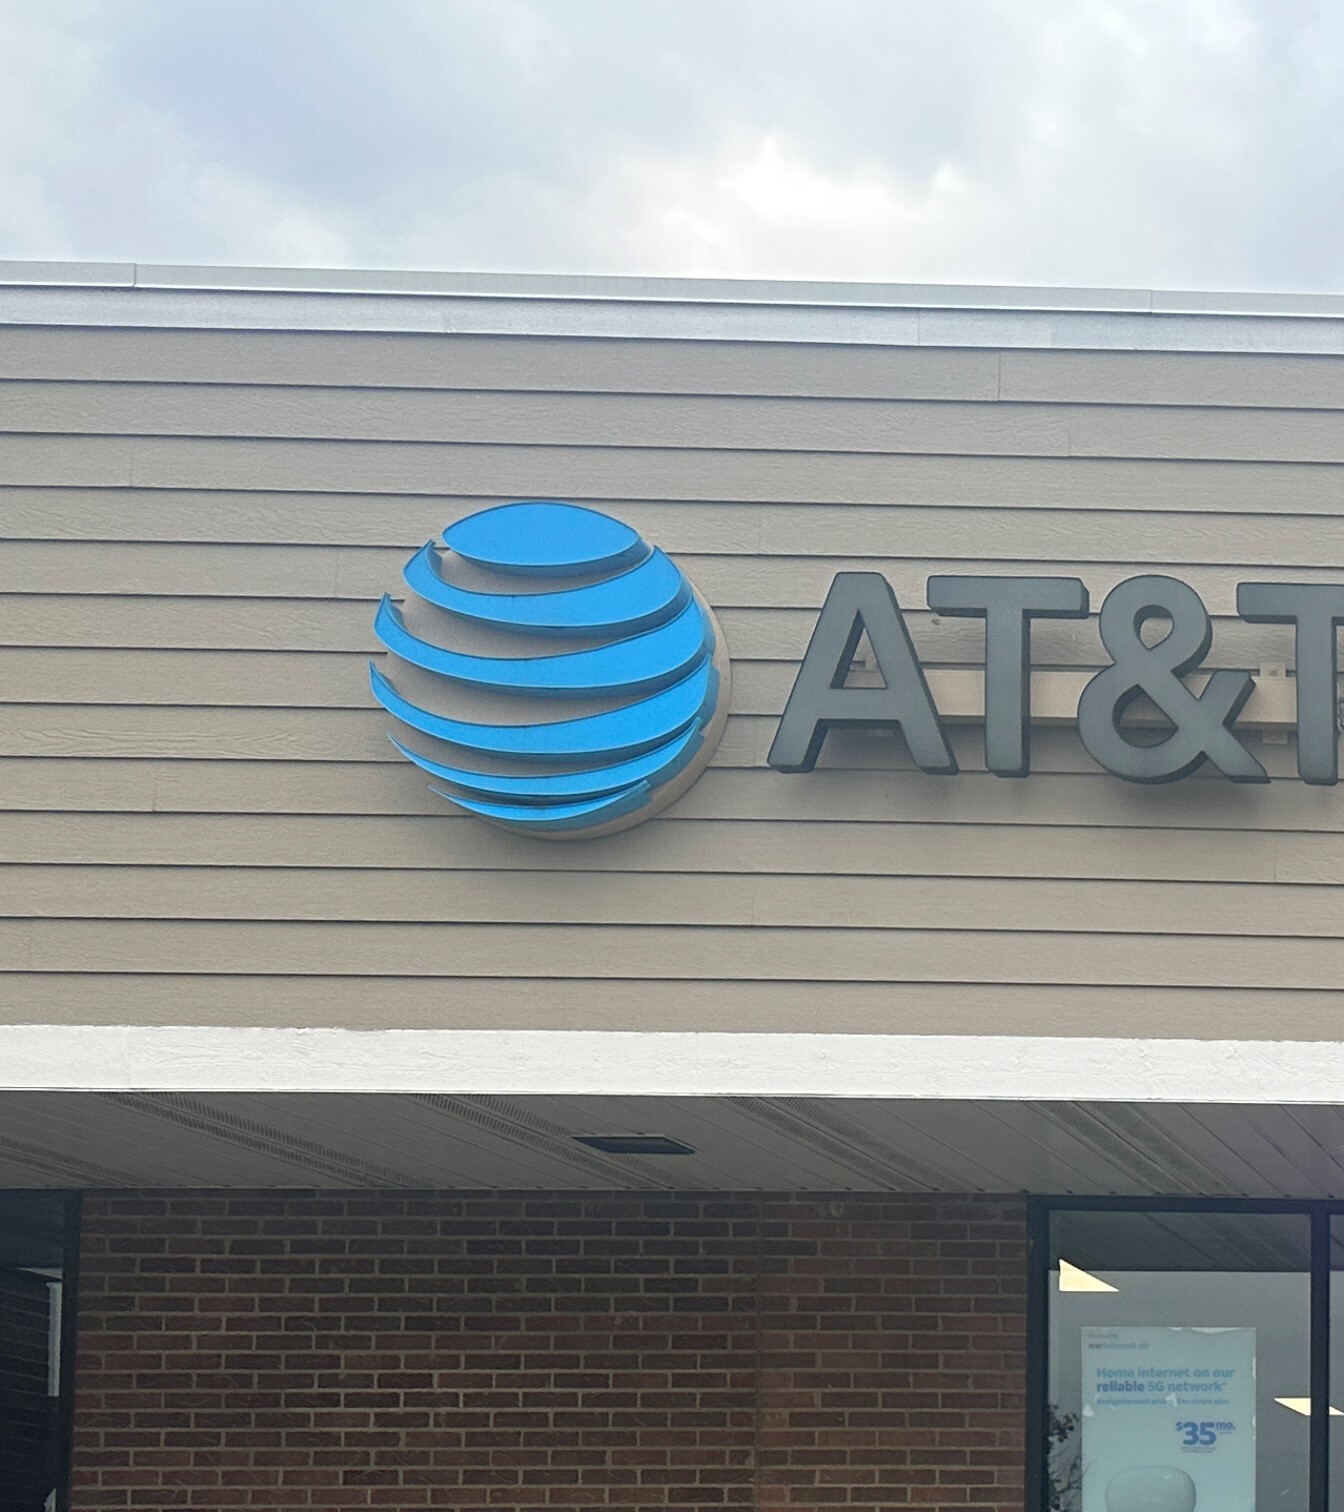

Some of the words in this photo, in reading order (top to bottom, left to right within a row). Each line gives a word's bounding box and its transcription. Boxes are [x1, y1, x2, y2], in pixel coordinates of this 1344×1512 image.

[1096, 1367, 1135, 1378] Home
[1193, 1369, 1210, 1378] on
[1212, 1369, 1236, 1378] our
[1096, 1381, 1145, 1392] reliable
[1147, 1381, 1165, 1392] 5G
[1175, 1420, 1217, 1446] $35
